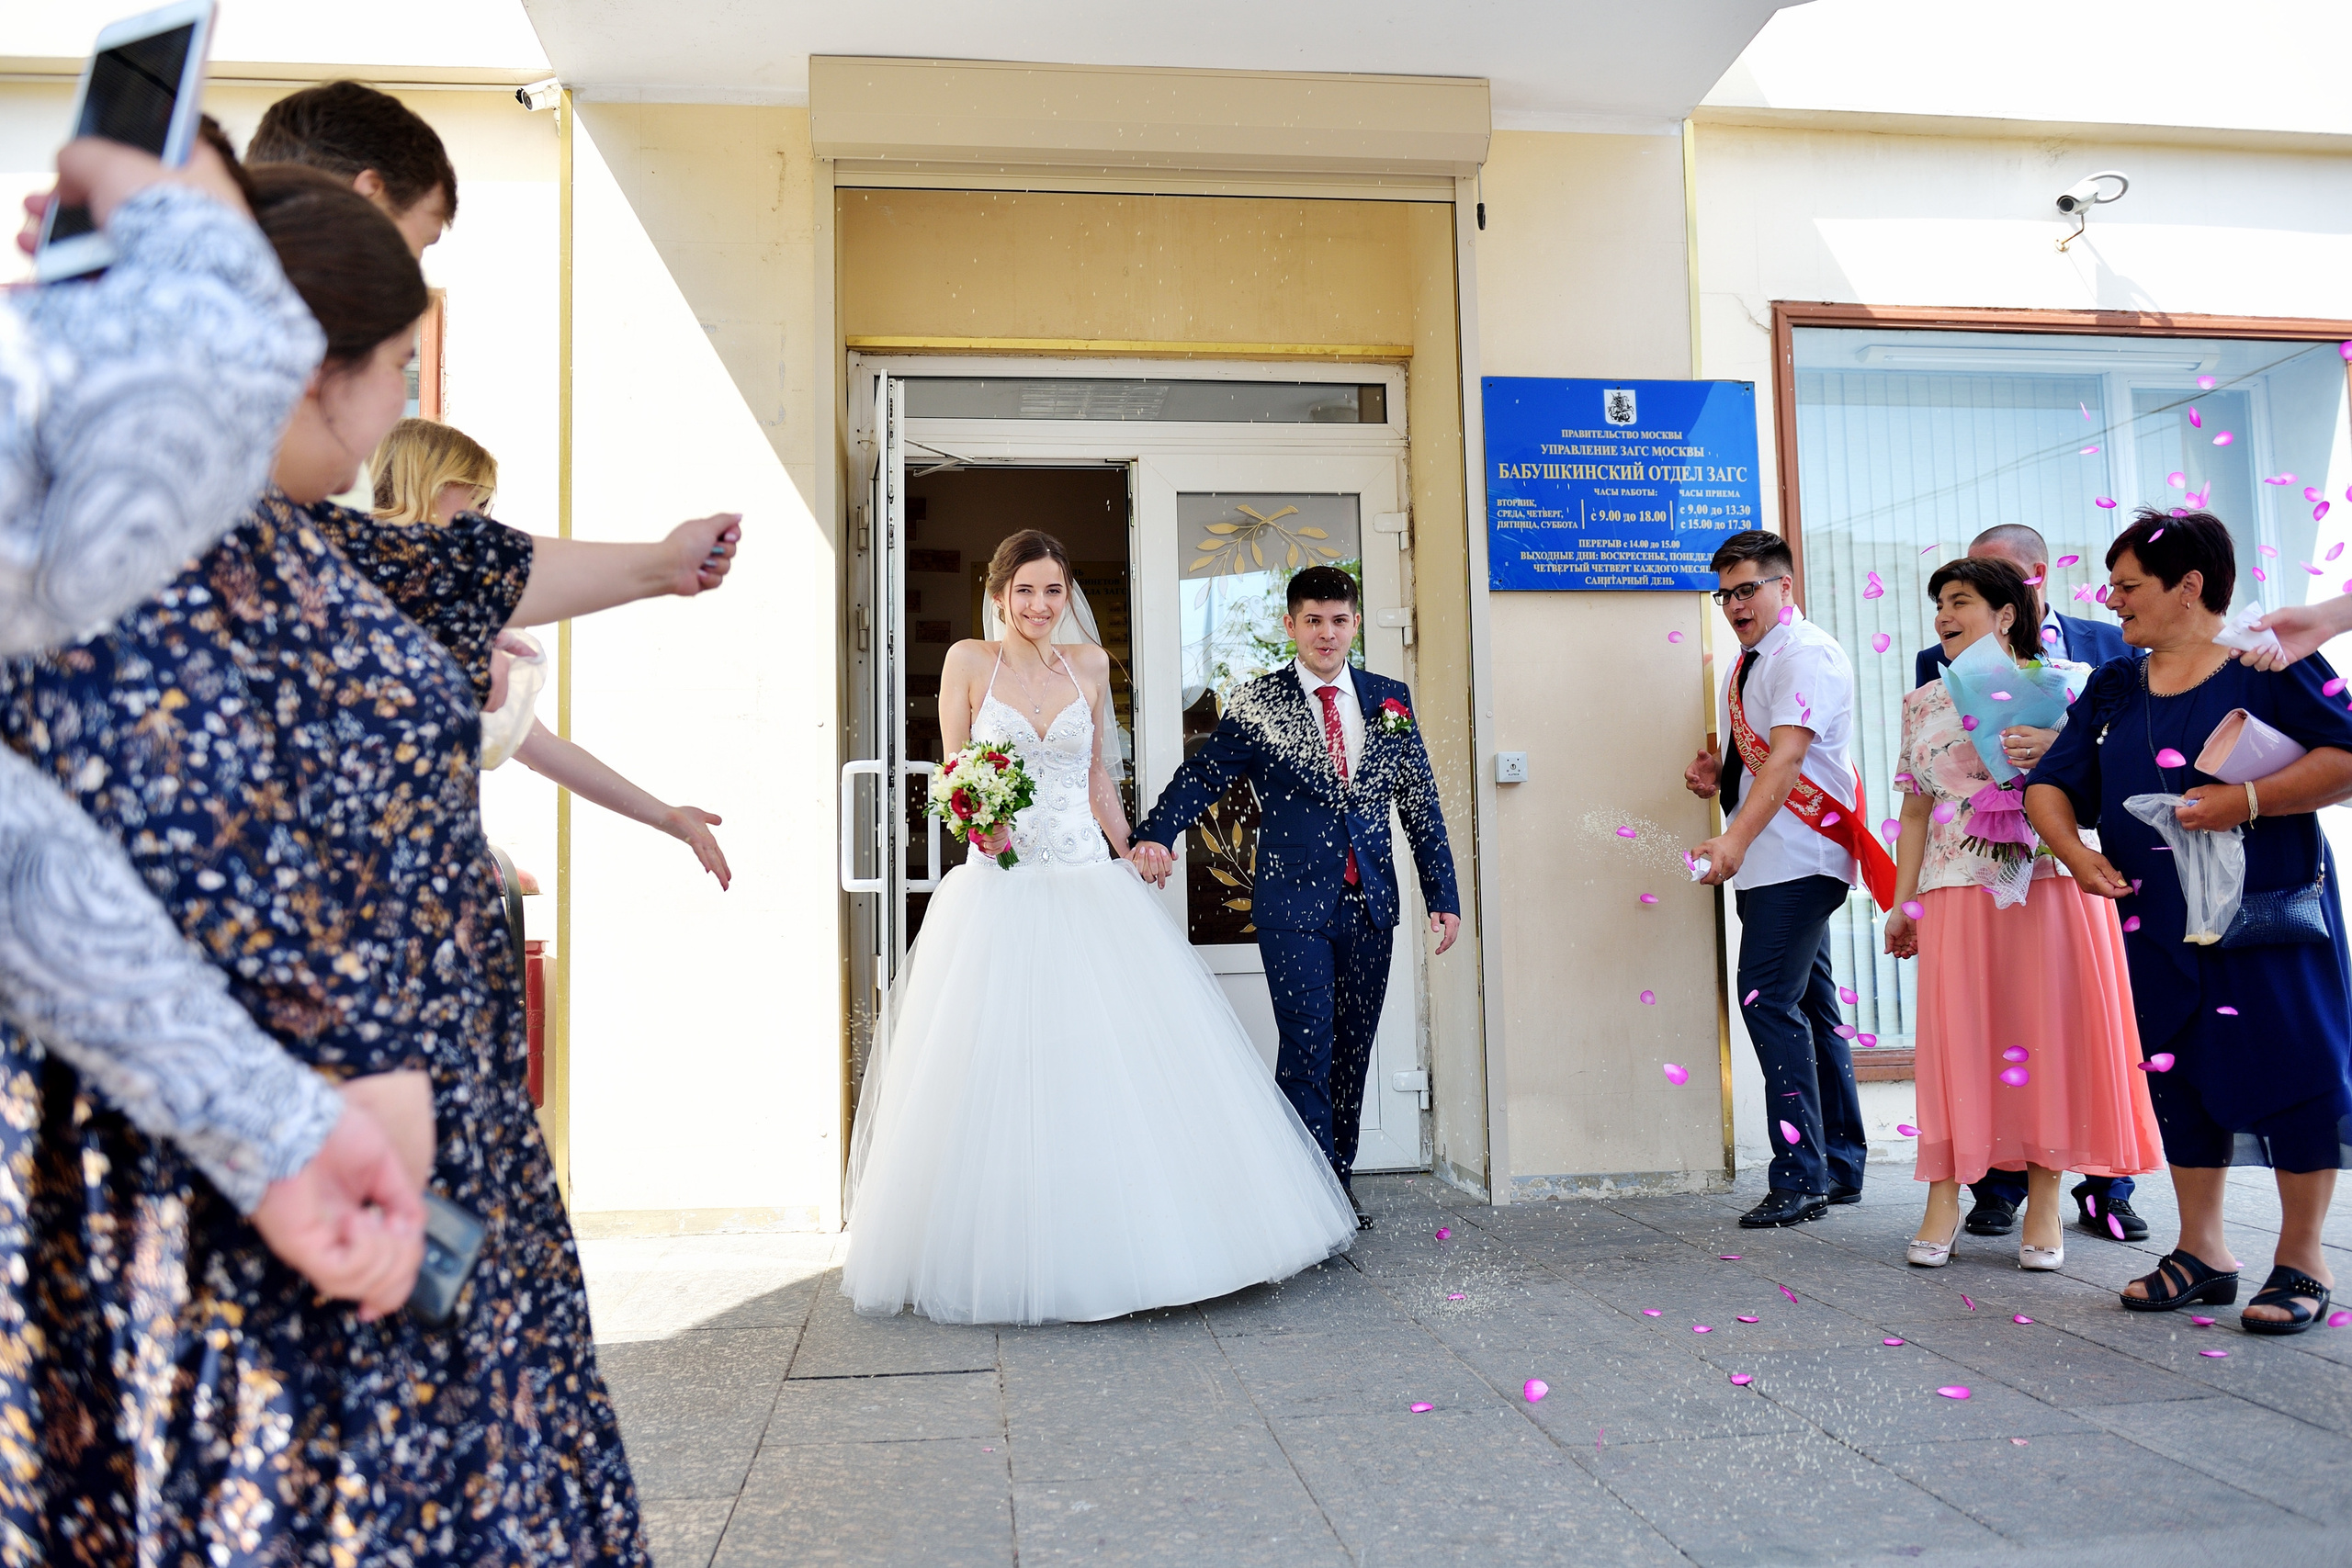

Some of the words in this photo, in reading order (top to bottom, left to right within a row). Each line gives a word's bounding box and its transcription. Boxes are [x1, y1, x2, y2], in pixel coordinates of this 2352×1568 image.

[1562, 430, 1639, 439] ПРАВИТЕЛЬСТВО
[1541, 445, 1617, 456] УПРАВЛЕНИЕ
[1621, 446, 1648, 456] ЗАГС
[1653, 446, 1704, 457] МОСКВЫ
[1498, 462, 1645, 480] БАБУШКИНСКИЙ
[1649, 466, 1703, 484] ОТДЕЛ
[1707, 467, 1747, 482] ЗАГС
[1498, 499, 1536, 507] ВТОРНИК,
[1498, 510, 1525, 518] СРЕДА,
[1527, 510, 1563, 518] ЧЕТВЕРГ,
[1688, 504, 1708, 514] 9.00
[1711, 507, 1722, 515] до
[1726, 505, 1750, 514] 13.30
[1600, 511, 1621, 521] 9.00
[1623, 513, 1636, 522] до
[1640, 511, 1666, 522] 18.00
[1498, 521, 1539, 530] ПЯТНИЦА,
[1689, 519, 1712, 529] 15.00
[1714, 522, 1725, 530] до
[1728, 520, 1751, 530] 17.30
[1662, 540, 1679, 548] 15.00
[1521, 552, 1574, 560] ВЫХОДНЫЕ
[1576, 552, 1598, 560] ДНИ:
[1600, 552, 1668, 561] ВОСКРЕСЕНЬЕ,
[1670, 553, 1713, 562] ПОНЕДЕЛ
[1533, 562, 1589, 573] ЧЕТВЕРТЫЙ
[1592, 564, 1631, 572] ЧЕТВЕРГ
[1634, 565, 1679, 573] КАЖДОГО
[1680, 565, 1719, 574] МЕСЯЦ
[1585, 575, 1648, 585] САНИТАРНЫЙ
[1651, 577, 1674, 585] ДЕНЬ
